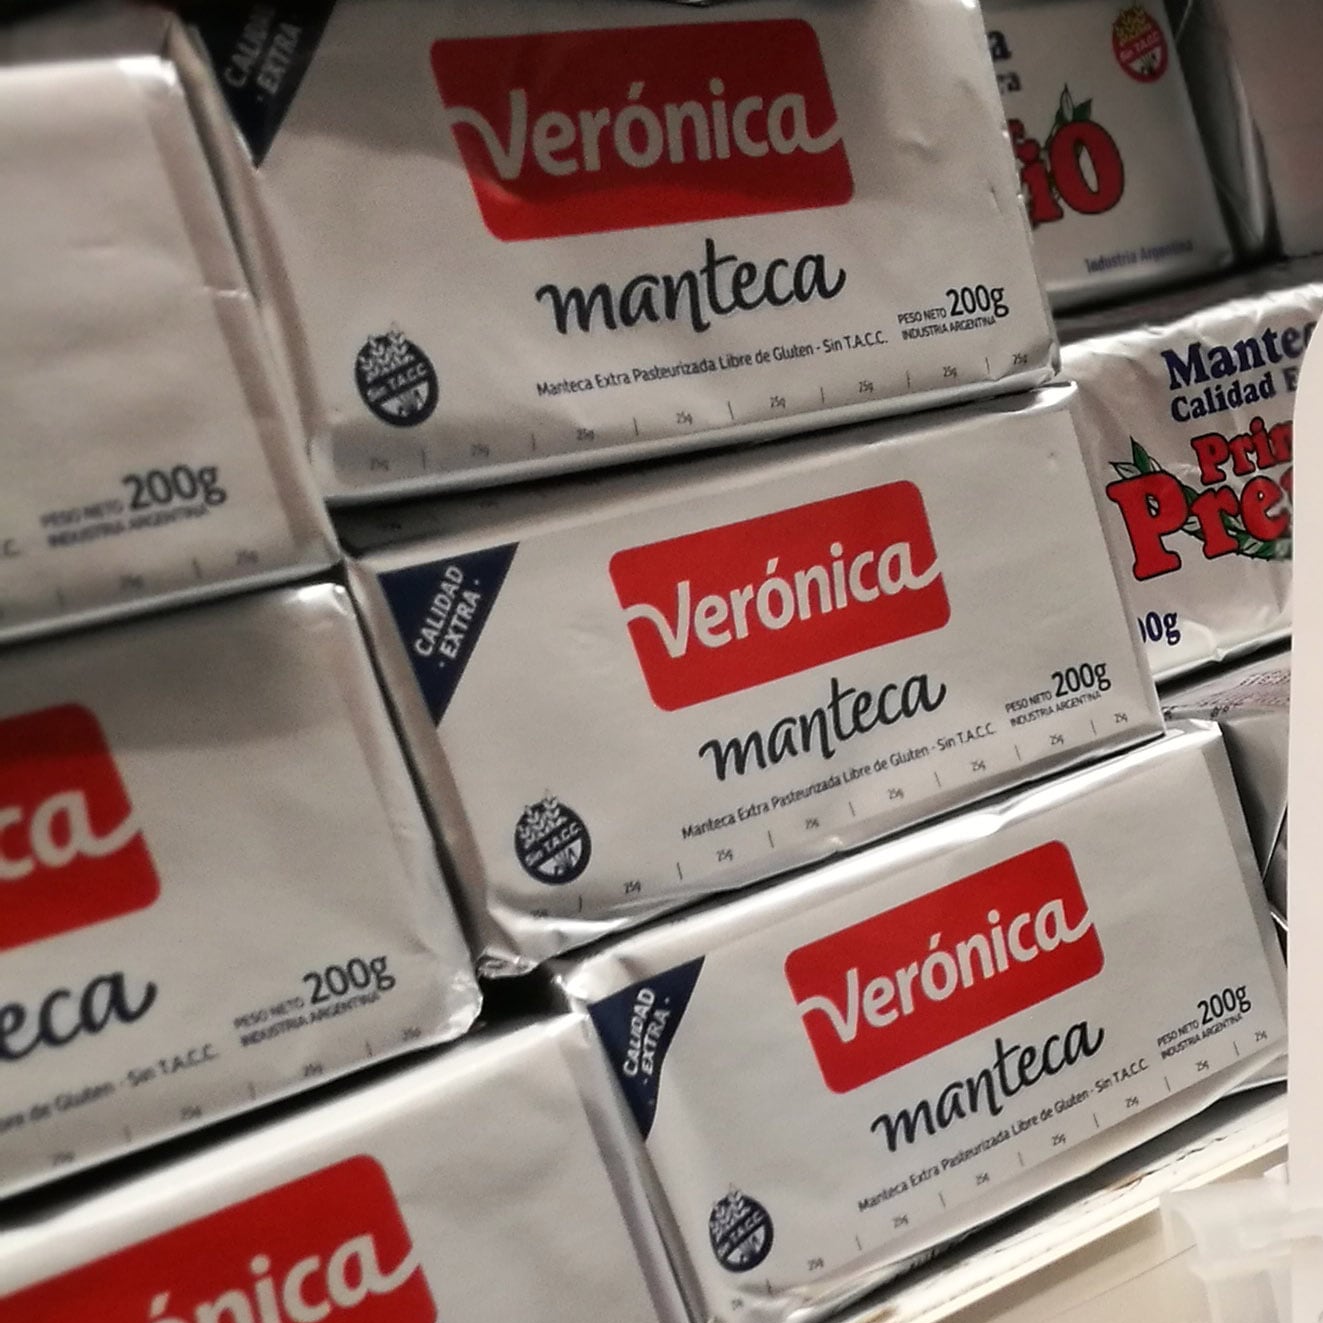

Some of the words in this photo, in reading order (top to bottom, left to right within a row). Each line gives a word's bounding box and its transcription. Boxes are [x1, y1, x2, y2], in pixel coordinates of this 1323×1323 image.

[443, 77, 843, 181] Verónica
[535, 237, 847, 335] manteca
[897, 311, 922, 325] PESO
[923, 307, 947, 322] NETO
[945, 284, 1010, 318] 200g
[901, 322, 948, 341] INDUSTRIA
[949, 315, 997, 334] ARGENTINA
[536, 378, 594, 398] Manteca
[595, 372, 631, 389] Extra
[718, 352, 753, 370] Libre
[754, 348, 772, 364] de
[772, 342, 814, 362] Gluten
[823, 335, 843, 354] Sin
[1170, 370, 1275, 423] Calidad
[122, 463, 228, 510] 200g
[1106, 472, 1294, 582] Pre
[414, 564, 464, 657] CALIDAD
[438, 589, 481, 660] EXTRA
[622, 541, 943, 659] Verónica
[1051, 662, 1112, 698] 200g
[698, 673, 947, 781] manteca
[1009, 705, 1055, 728] INDUSTRIA
[681, 813, 737, 840] Manteca
[737, 802, 771, 822] Extra
[842, 763, 873, 784] Libre
[873, 758, 888, 773] de
[889, 745, 929, 768] Gluten
[937, 735, 956, 752] Sin
[303, 955, 397, 1005] 200g
[797, 898, 1094, 1044] Verónica
[1197, 985, 1252, 1026] 200g
[623, 988, 656, 1077] CALIDAD
[641, 1009, 671, 1076] EXTRA
[869, 1020, 1105, 1152] manteca
[858, 1177, 909, 1213] Manteca
[909, 1162, 940, 1187] Extra
[1011, 1113, 1039, 1137] Libre
[1039, 1106, 1054, 1122] de
